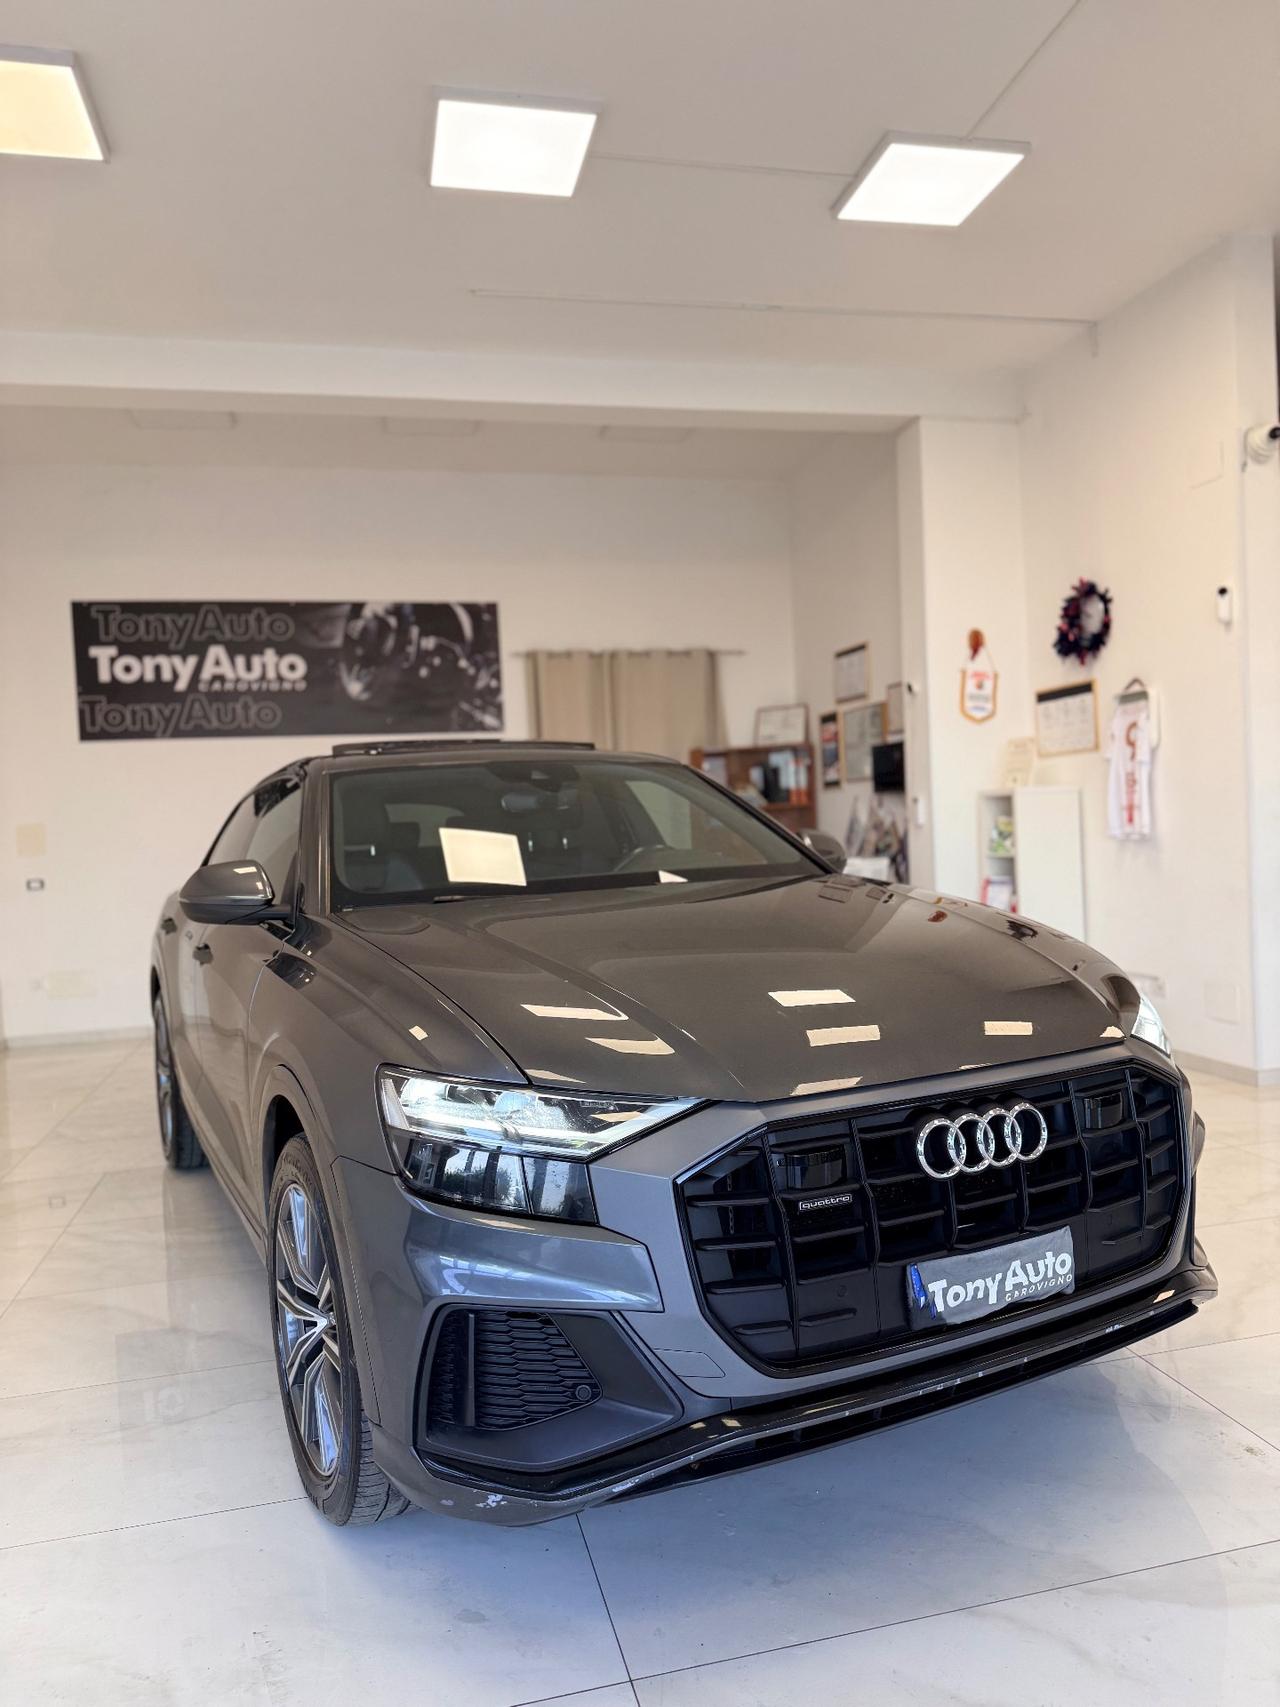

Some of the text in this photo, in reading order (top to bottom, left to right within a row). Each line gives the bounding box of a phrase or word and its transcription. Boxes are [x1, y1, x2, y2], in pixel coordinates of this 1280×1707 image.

[91, 604, 296, 650] Tony Auto
[88, 644, 308, 692] Tony Auto
[802, 1196, 850, 1209] quattro
[927, 1251, 1073, 1313] Tony Auto
[1005, 1274, 1073, 1302] CAROVIGNO
